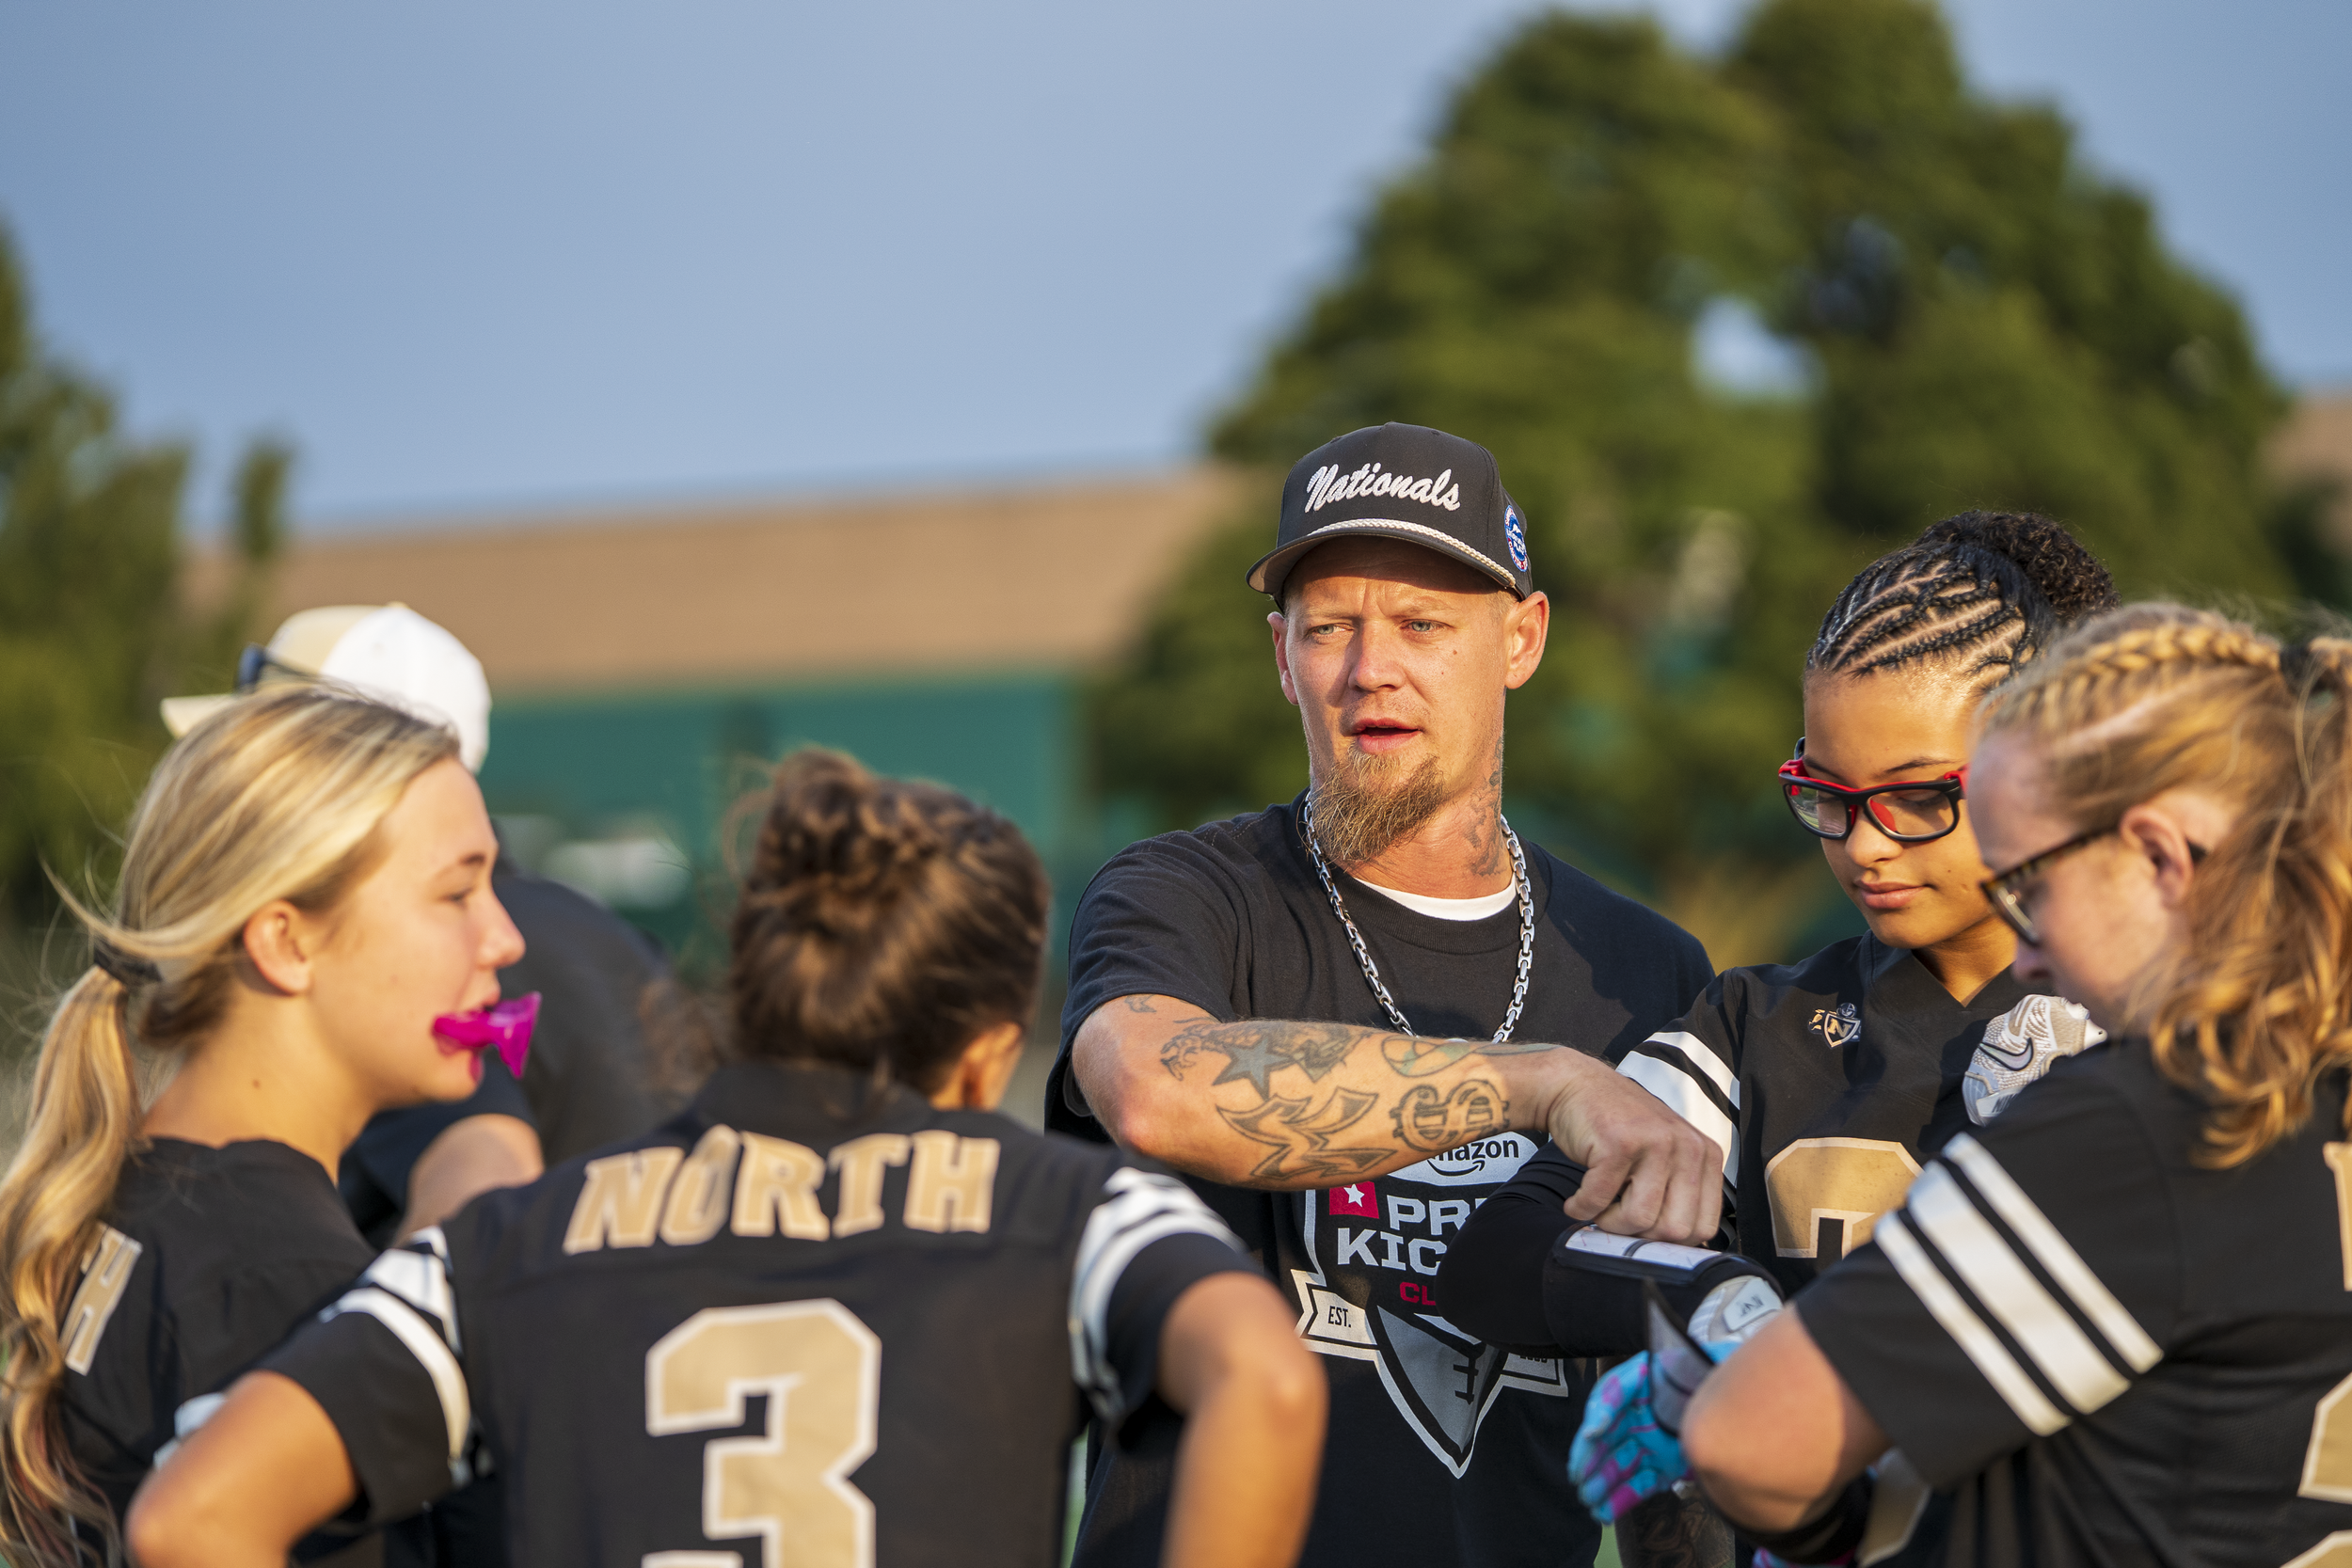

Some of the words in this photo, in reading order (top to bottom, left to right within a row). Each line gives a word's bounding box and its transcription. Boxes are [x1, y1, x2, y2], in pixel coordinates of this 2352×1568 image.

[1304, 462, 1460, 513] Nationals
[563, 1124, 1001, 1256] NORTH
[1386, 1195, 1487, 1236] PR
[1337, 1227, 1448, 1276] KIC
[1327, 1305, 1352, 1328] EST.
[1399, 1281, 1437, 1307] CL
[641, 1296, 882, 1568] 3
